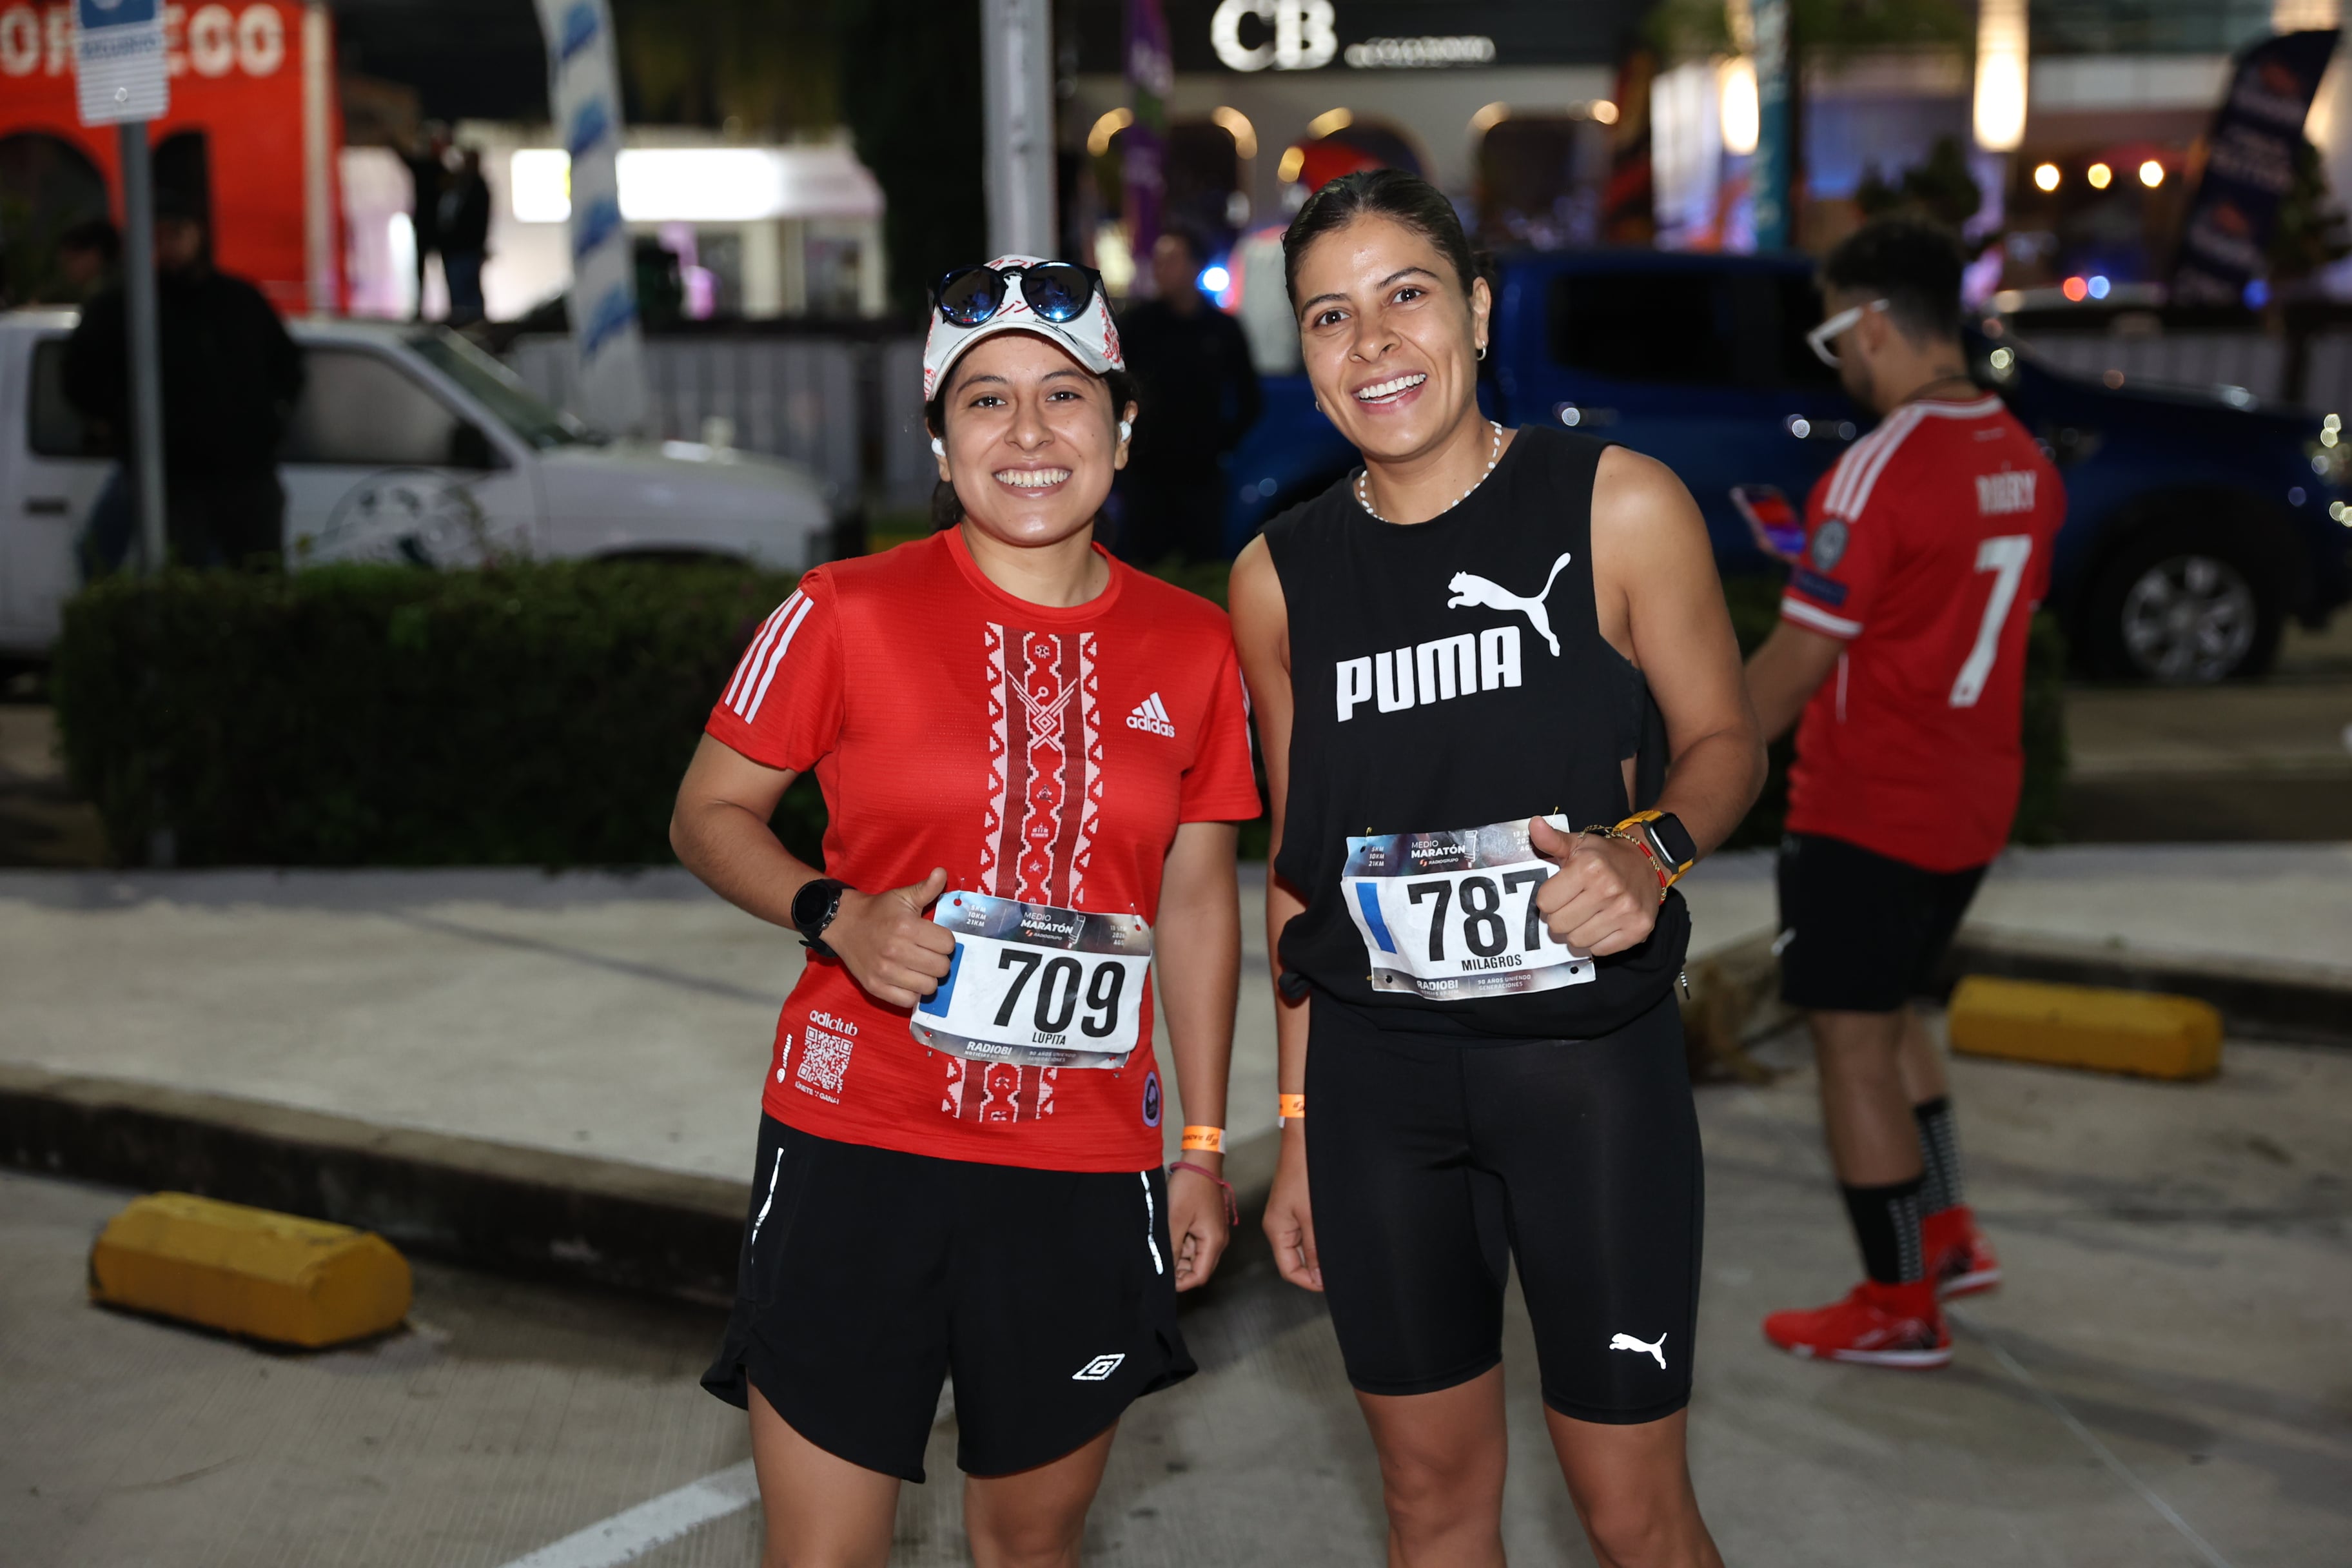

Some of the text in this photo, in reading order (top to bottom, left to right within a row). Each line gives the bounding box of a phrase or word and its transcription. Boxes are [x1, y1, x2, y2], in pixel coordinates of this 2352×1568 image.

[1210, 0, 1338, 72] CB
[1948, 534, 2033, 708] 7
[1336, 625, 1522, 723] PUMA
[1126, 715, 1175, 738] adidas
[1411, 840, 1439, 848] MEDIO
[1411, 843, 1465, 859] MARATÓN
[968, 912, 986, 921] 10KM
[1024, 912, 1052, 922] MEDIO
[1407, 867, 1549, 962] 787
[966, 918, 985, 928] 21KM
[1020, 919, 1073, 934] MARATÓN
[1461, 954, 1522, 972] MILAGROS
[993, 948, 1126, 1038] 709
[1416, 979, 1458, 991] RADIOBI
[809, 1010, 858, 1037] adiclub
[1032, 1032, 1066, 1046] LUPITA
[966, 1041, 1013, 1055] RADIOBI
